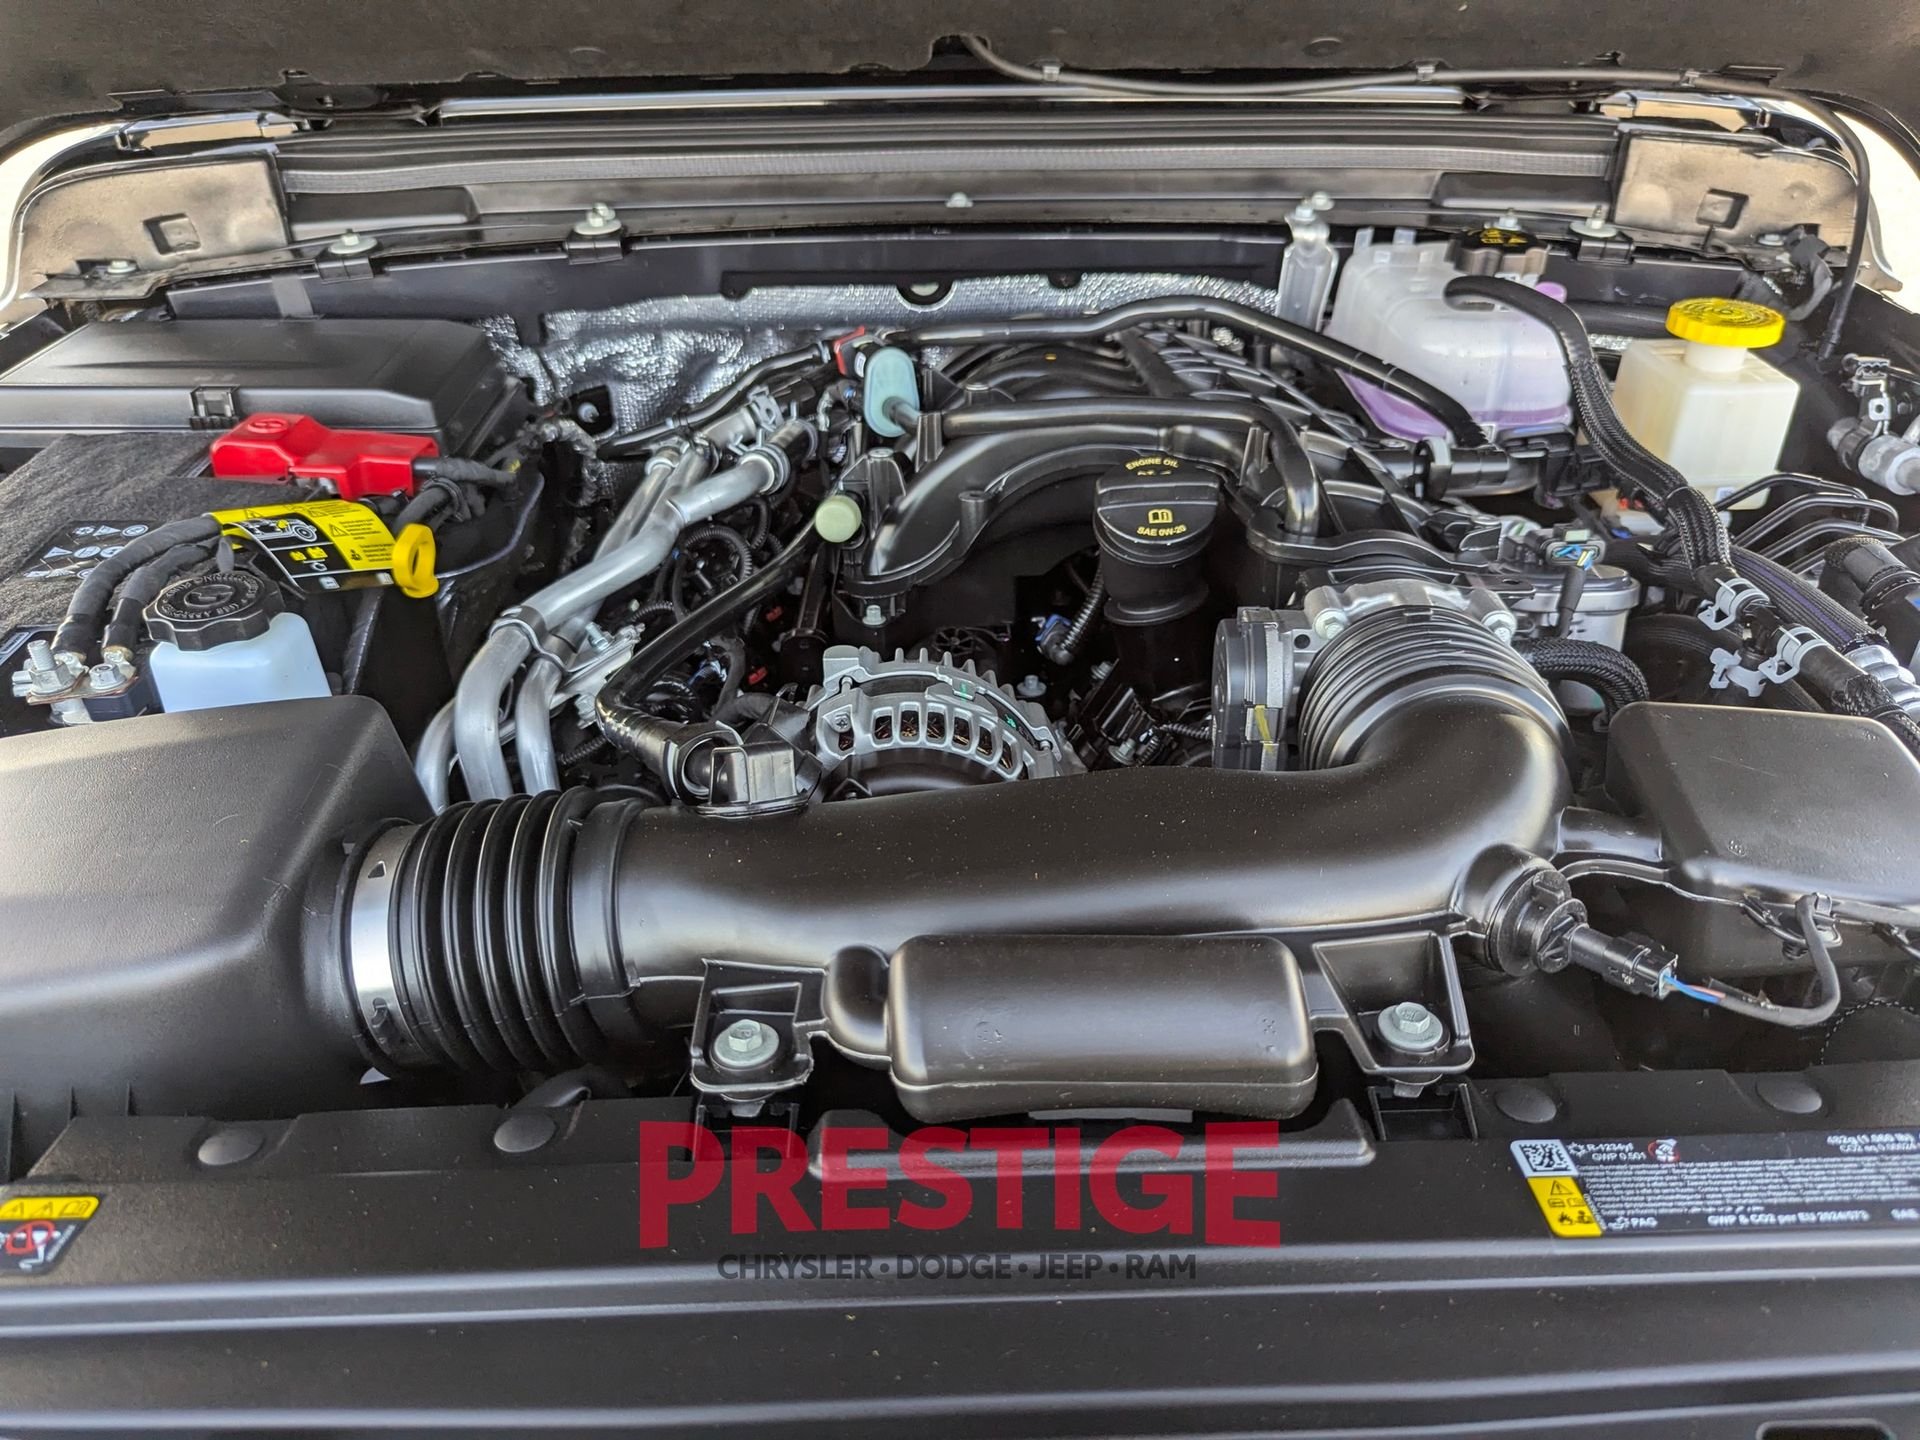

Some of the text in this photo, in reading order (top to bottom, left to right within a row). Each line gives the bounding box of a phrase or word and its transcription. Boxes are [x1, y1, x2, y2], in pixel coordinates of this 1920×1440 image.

[1125, 457, 1180, 470] ENGINE OIL
[1136, 524, 1187, 537] SAE 0W-20
